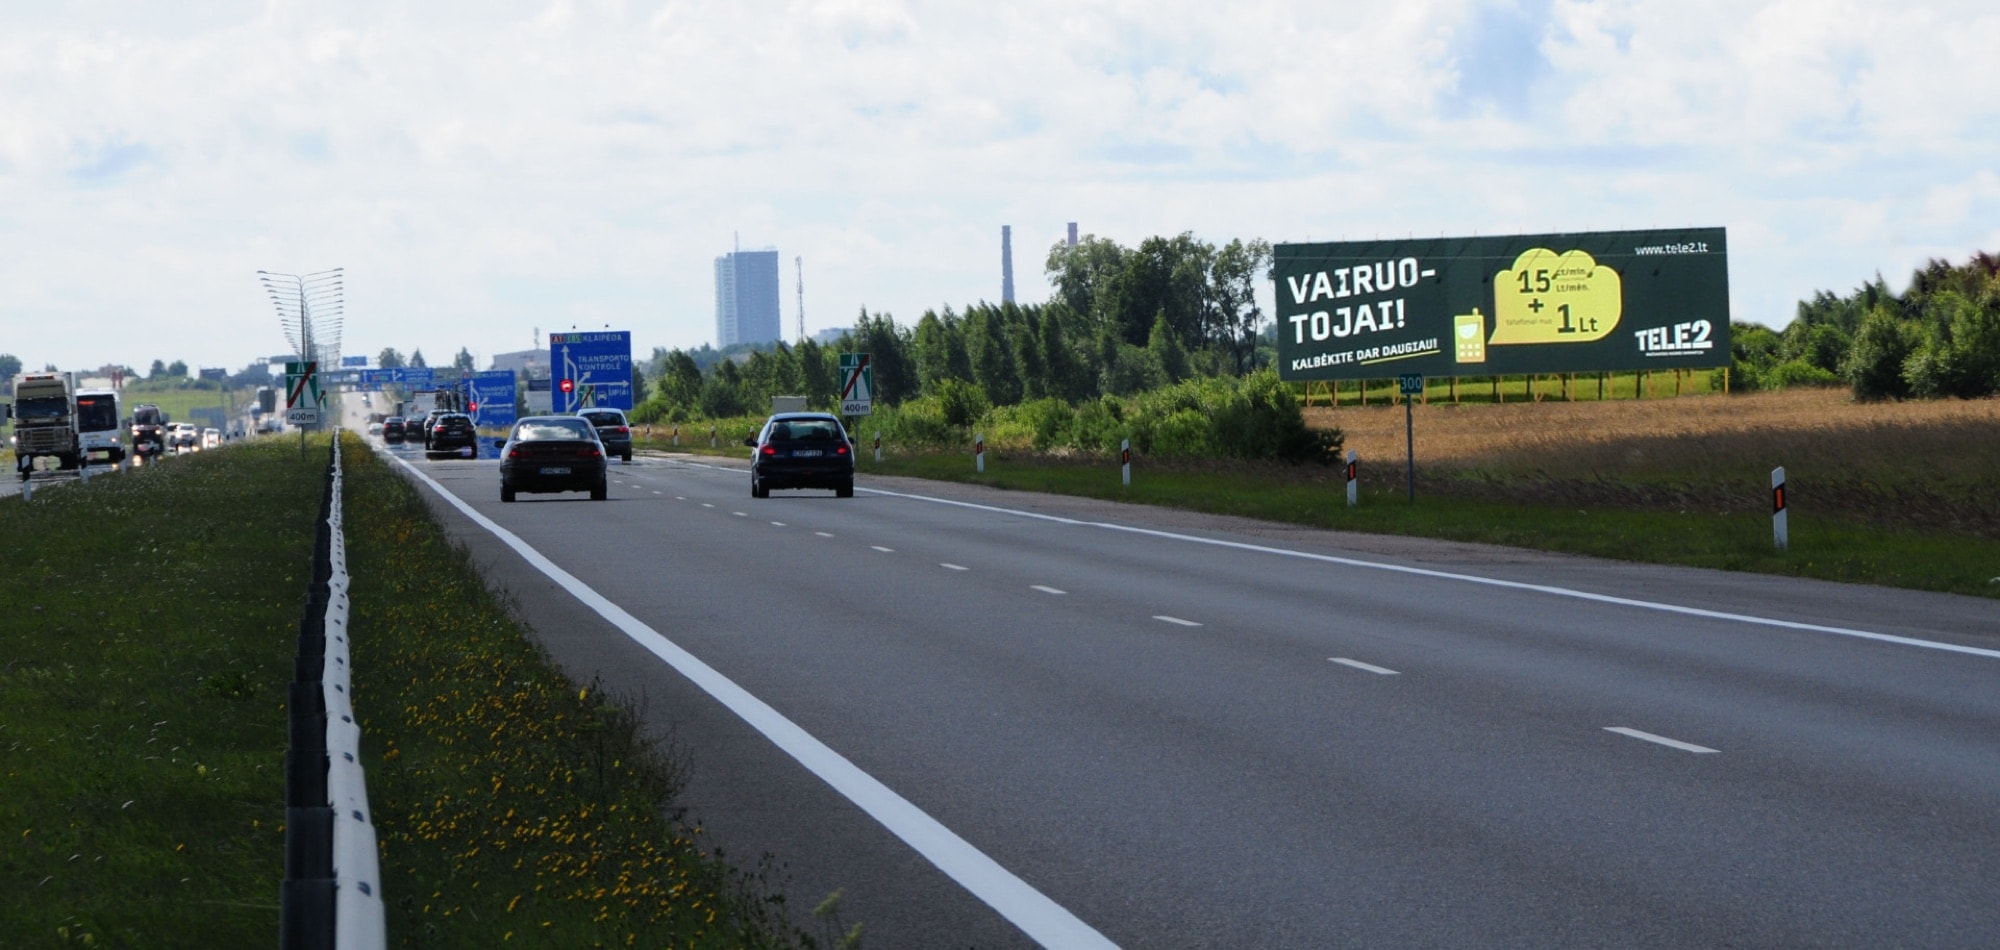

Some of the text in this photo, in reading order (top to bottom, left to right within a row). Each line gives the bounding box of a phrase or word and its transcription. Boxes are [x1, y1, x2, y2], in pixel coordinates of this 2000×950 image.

[1635, 242, 1708, 255] www.tele2.lt
[1287, 257, 1436, 304] VAIRUO-
[1517, 269, 1551, 294] 15
[1289, 299, 1405, 344] TOJAI!
[1557, 304, 1599, 333] 1 Lt
[1634, 319, 1713, 351] TELE2
[578, 354, 629, 363] TRANSPORTO
[578, 361, 621, 371] KONTROLĖ
[1292, 338, 1438, 371] KALBĖKITE DAR DAUGIAU!
[1400, 376, 1422, 390] 300
[844, 403, 869, 412] 400m
